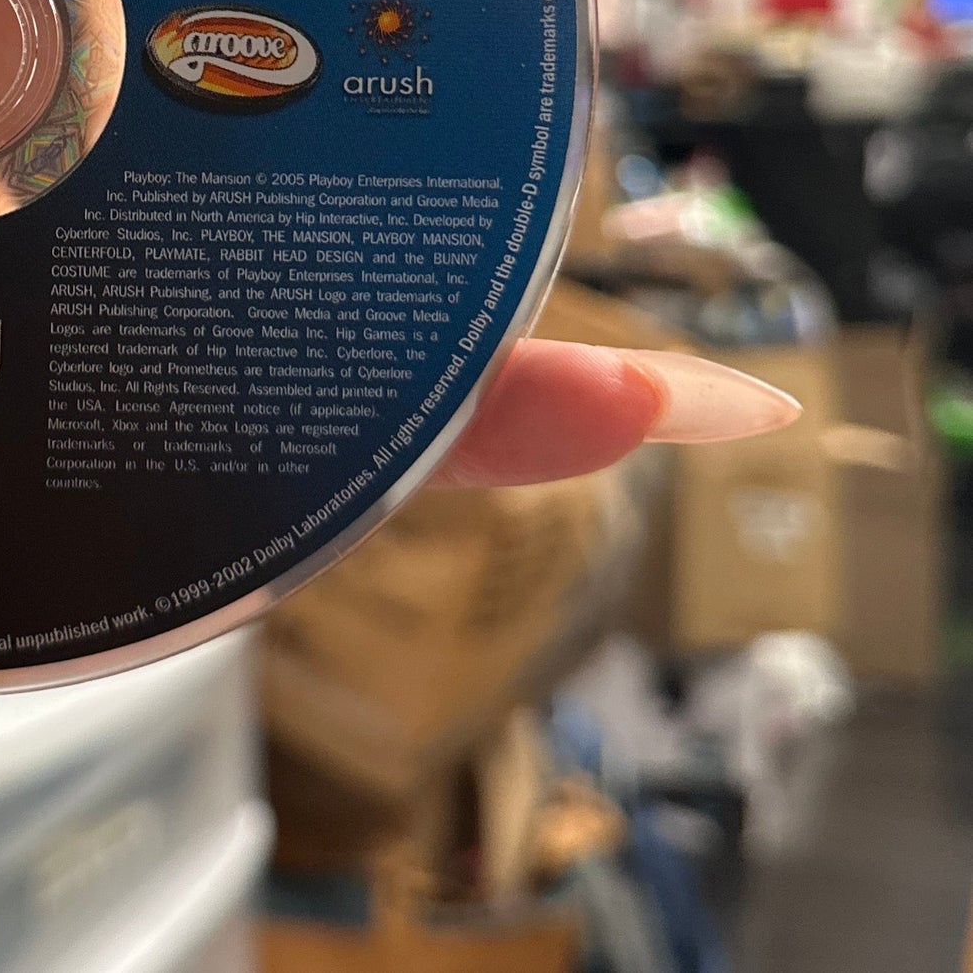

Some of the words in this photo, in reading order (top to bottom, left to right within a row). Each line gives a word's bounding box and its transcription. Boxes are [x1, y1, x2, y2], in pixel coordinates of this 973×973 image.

[537, 5, 556, 94] trademarks
[343, 65, 433, 95] arush
[539, 97, 553, 122] are
[528, 124, 550, 181] symbol
[173, 171, 198, 183] The
[201, 171, 251, 184] Mansion
[271, 172, 306, 185] 2005
[308, 173, 354, 189] Playboy
[357, 174, 423, 190] Enterprises
[131, 189, 189, 202] Published
[191, 190, 207, 205] by
[208, 190, 251, 203] ARUSH
[255, 191, 315, 207] Publishing
[318, 192, 387, 209] Corporation
[390, 193, 413, 206] and
[416, 194, 458, 207] Groove
[461, 195, 499, 207] Media
[109, 208, 173, 221] Distributed
[175, 209, 187, 221] in
[190, 209, 223, 222] North
[226, 210, 275, 223] America
[277, 211, 292, 226] by
[295, 211, 315, 227] Hip
[413, 213, 475, 229] Developed
[478, 214, 493, 230] by
[503, 181, 538, 252] double-D
[55, 226, 110, 242] Cyberlore
[261, 229, 286, 242] THE
[362, 231, 415, 244] PLAYBOY
[219, 248, 264, 261] RABBIT
[272, 249, 307, 261] HEAD
[315, 249, 363, 262] DESIGN
[372, 250, 397, 263] and
[404, 251, 425, 263] the
[433, 251, 477, 264] BUNNY
[491, 253, 515, 280] the
[51, 264, 111, 277] COSTUME
[117, 268, 137, 278] are
[144, 266, 211, 279] trademarks
[217, 267, 230, 279] of
[236, 267, 282, 283] Playboy
[288, 268, 354, 285] Enterprises
[101, 284, 145, 297] ARUSH
[217, 286, 241, 299] and
[245, 287, 265, 299] the
[269, 287, 313, 300] ARUSH
[318, 288, 347, 304] Logo
[351, 291, 371, 301] are
[376, 289, 443, 302] trademarks
[447, 290, 460, 302] of
[481, 278, 504, 310] and
[49, 303, 92, 315] ARUSH
[98, 303, 158, 320] Publishing
[247, 306, 289, 319] Groove
[294, 307, 331, 320] Media
[336, 308, 360, 320] and
[365, 308, 407, 321] Groove
[412, 309, 449, 322] Media
[456, 309, 493, 352] Dolby
[49, 341, 109, 357] registered
[117, 342, 178, 355] trademark
[185, 343, 199, 355] of
[206, 343, 227, 359] Hip
[235, 344, 297, 357] Interactive
[405, 347, 426, 359] the
[418, 352, 467, 415] reserved.
[388, 411, 424, 452] rights
[368, 444, 393, 469] All
[290, 468, 377, 539] Laboratories.
[251, 531, 298, 565] Dolby
[152, 554, 255, 614] ©1999-2002
[110, 603, 152, 628] work.
[15, 615, 109, 649] unpublished
